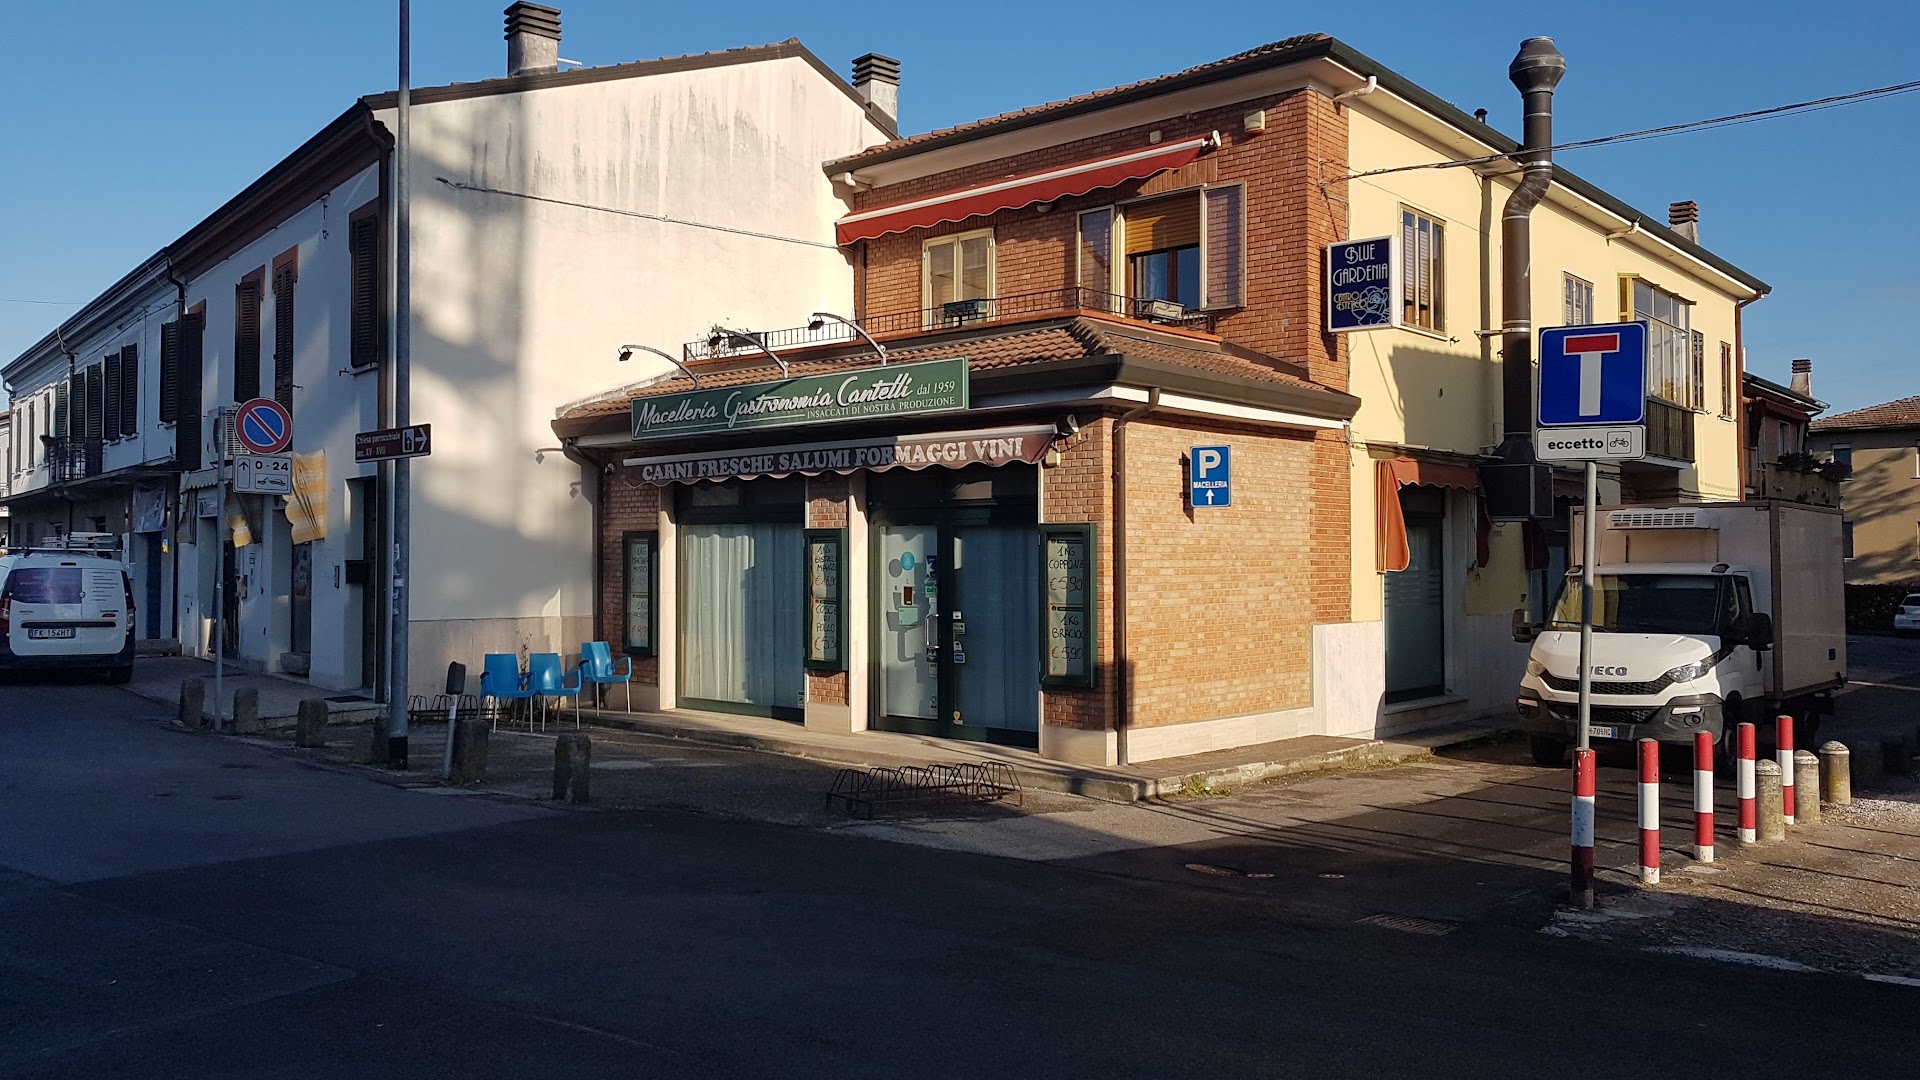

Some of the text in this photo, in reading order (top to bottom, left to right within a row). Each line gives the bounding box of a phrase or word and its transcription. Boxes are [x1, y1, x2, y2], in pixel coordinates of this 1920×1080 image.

[1344, 243, 1376, 265] BLUE
[1332, 263, 1388, 287] GARDENIA
[634, 372, 956, 437] Macelleria Gastronomia Cantelli dal 1959
[807, 396, 956, 419] INSACCATI DI NOSTRA PRODUZIONE
[356, 431, 401, 445] Chiesa parrocchiale
[1547, 437, 1604, 450] eccetto
[272, 461, 289, 472] 24
[642, 436, 1024, 482] CARNI FRESCHE SALUMI FORMAGGI VINI
[1199, 449, 1222, 479] P
[1192, 480, 1228, 489] MACELLERIA
[816, 564, 836, 573] MANZ
[1576, 665, 1628, 677] IECO
